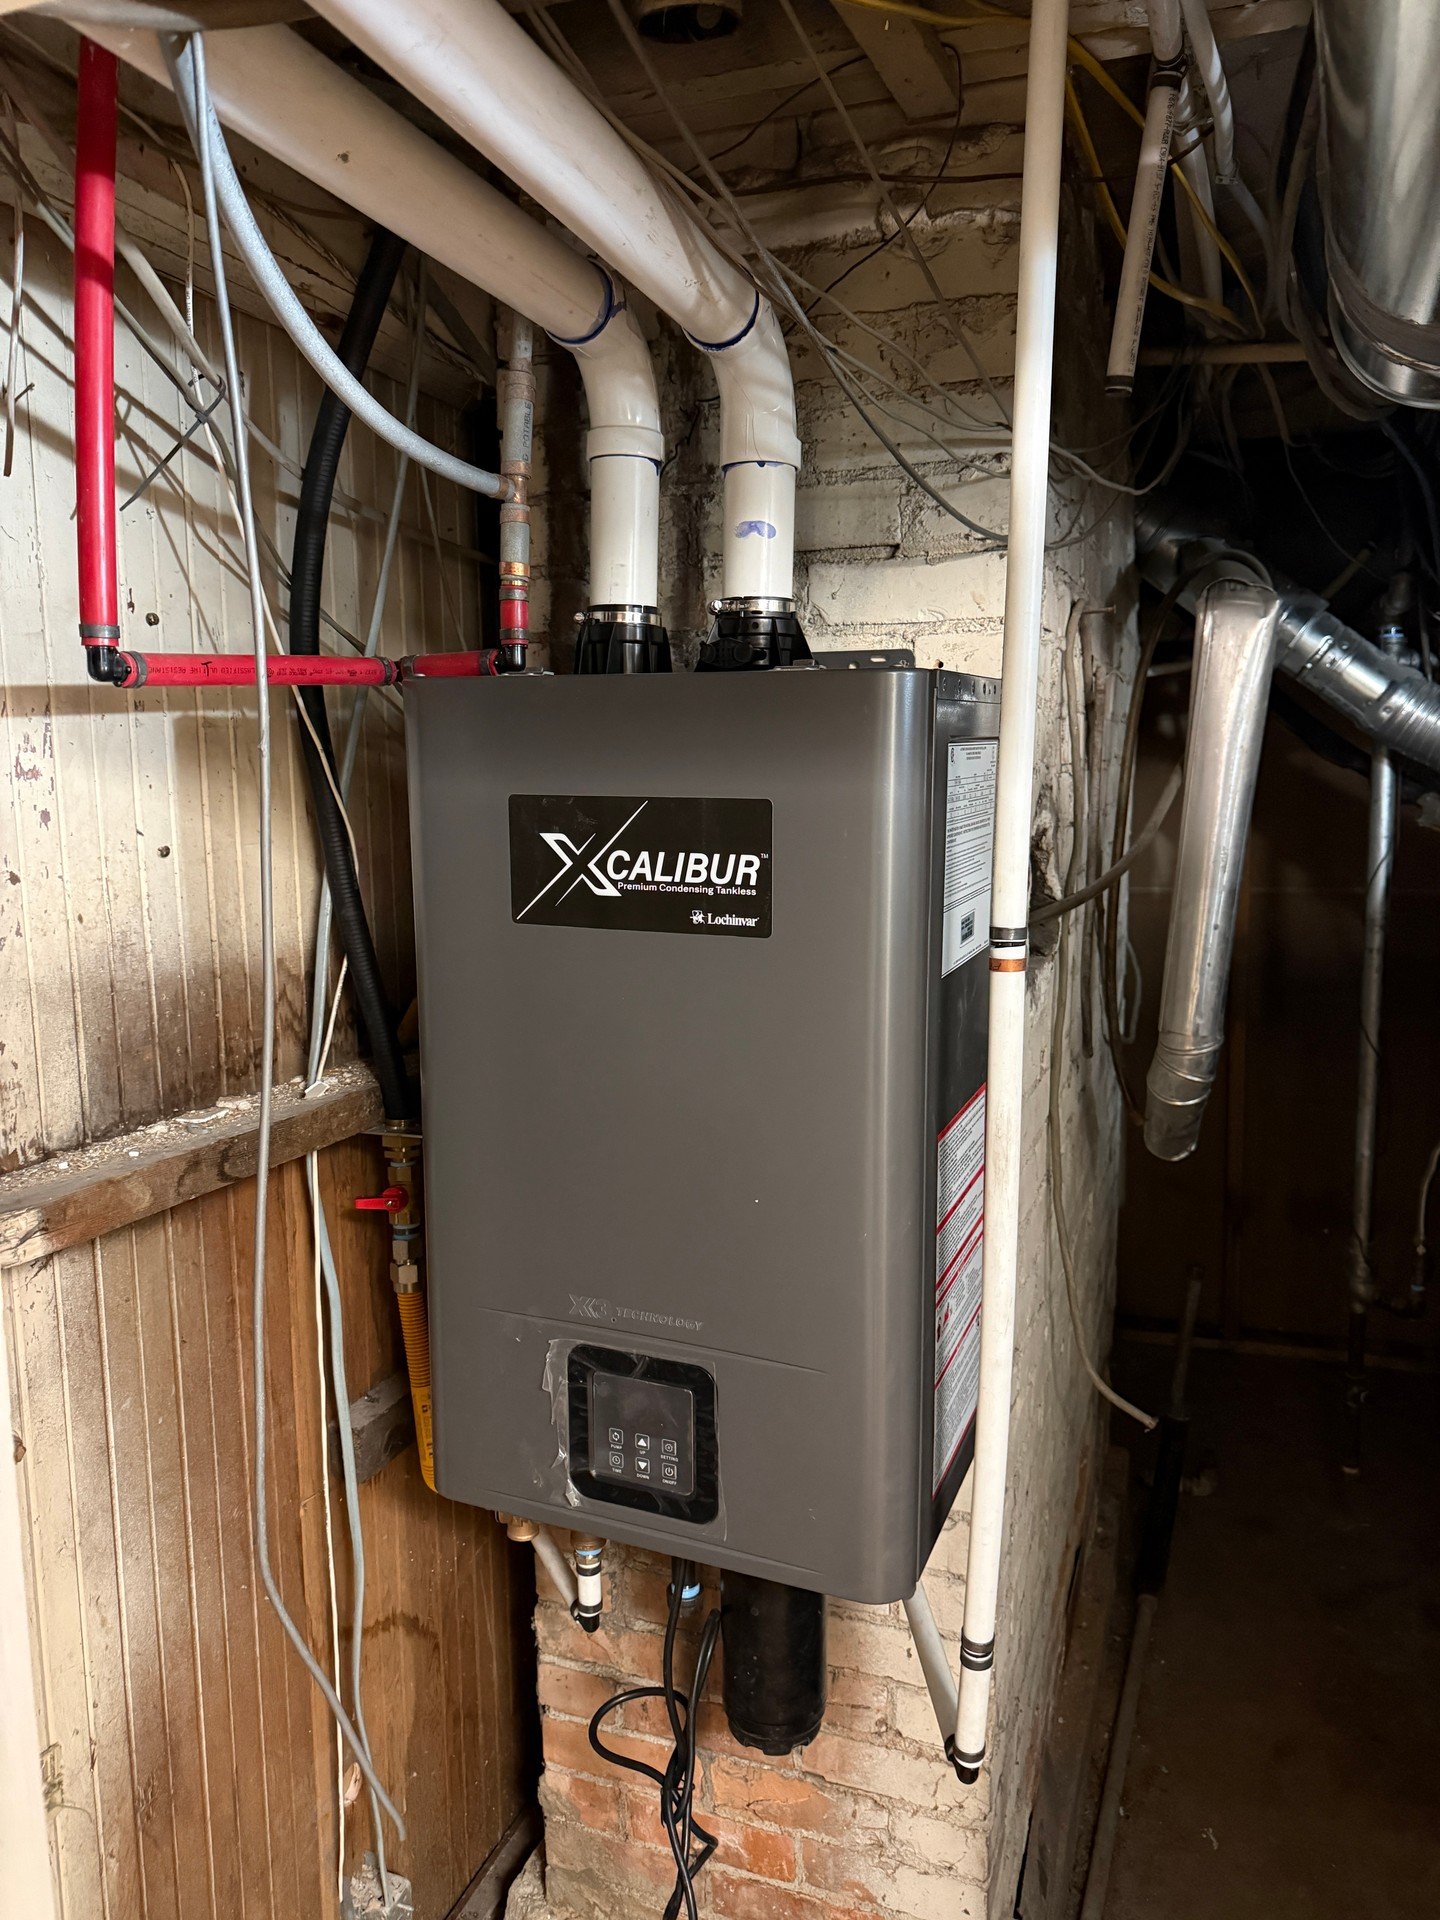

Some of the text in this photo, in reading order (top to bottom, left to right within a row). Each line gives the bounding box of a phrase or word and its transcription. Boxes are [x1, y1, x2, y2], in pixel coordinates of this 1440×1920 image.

[522, 401, 531, 448] POTABLE
[220, 667, 255, 675] LASSIFIED
[617, 881, 757, 896] Premium Condensing Tankless
[707, 912, 758, 927] Lochinvar
[616, 1306, 703, 1331] TECHNOLOGY
